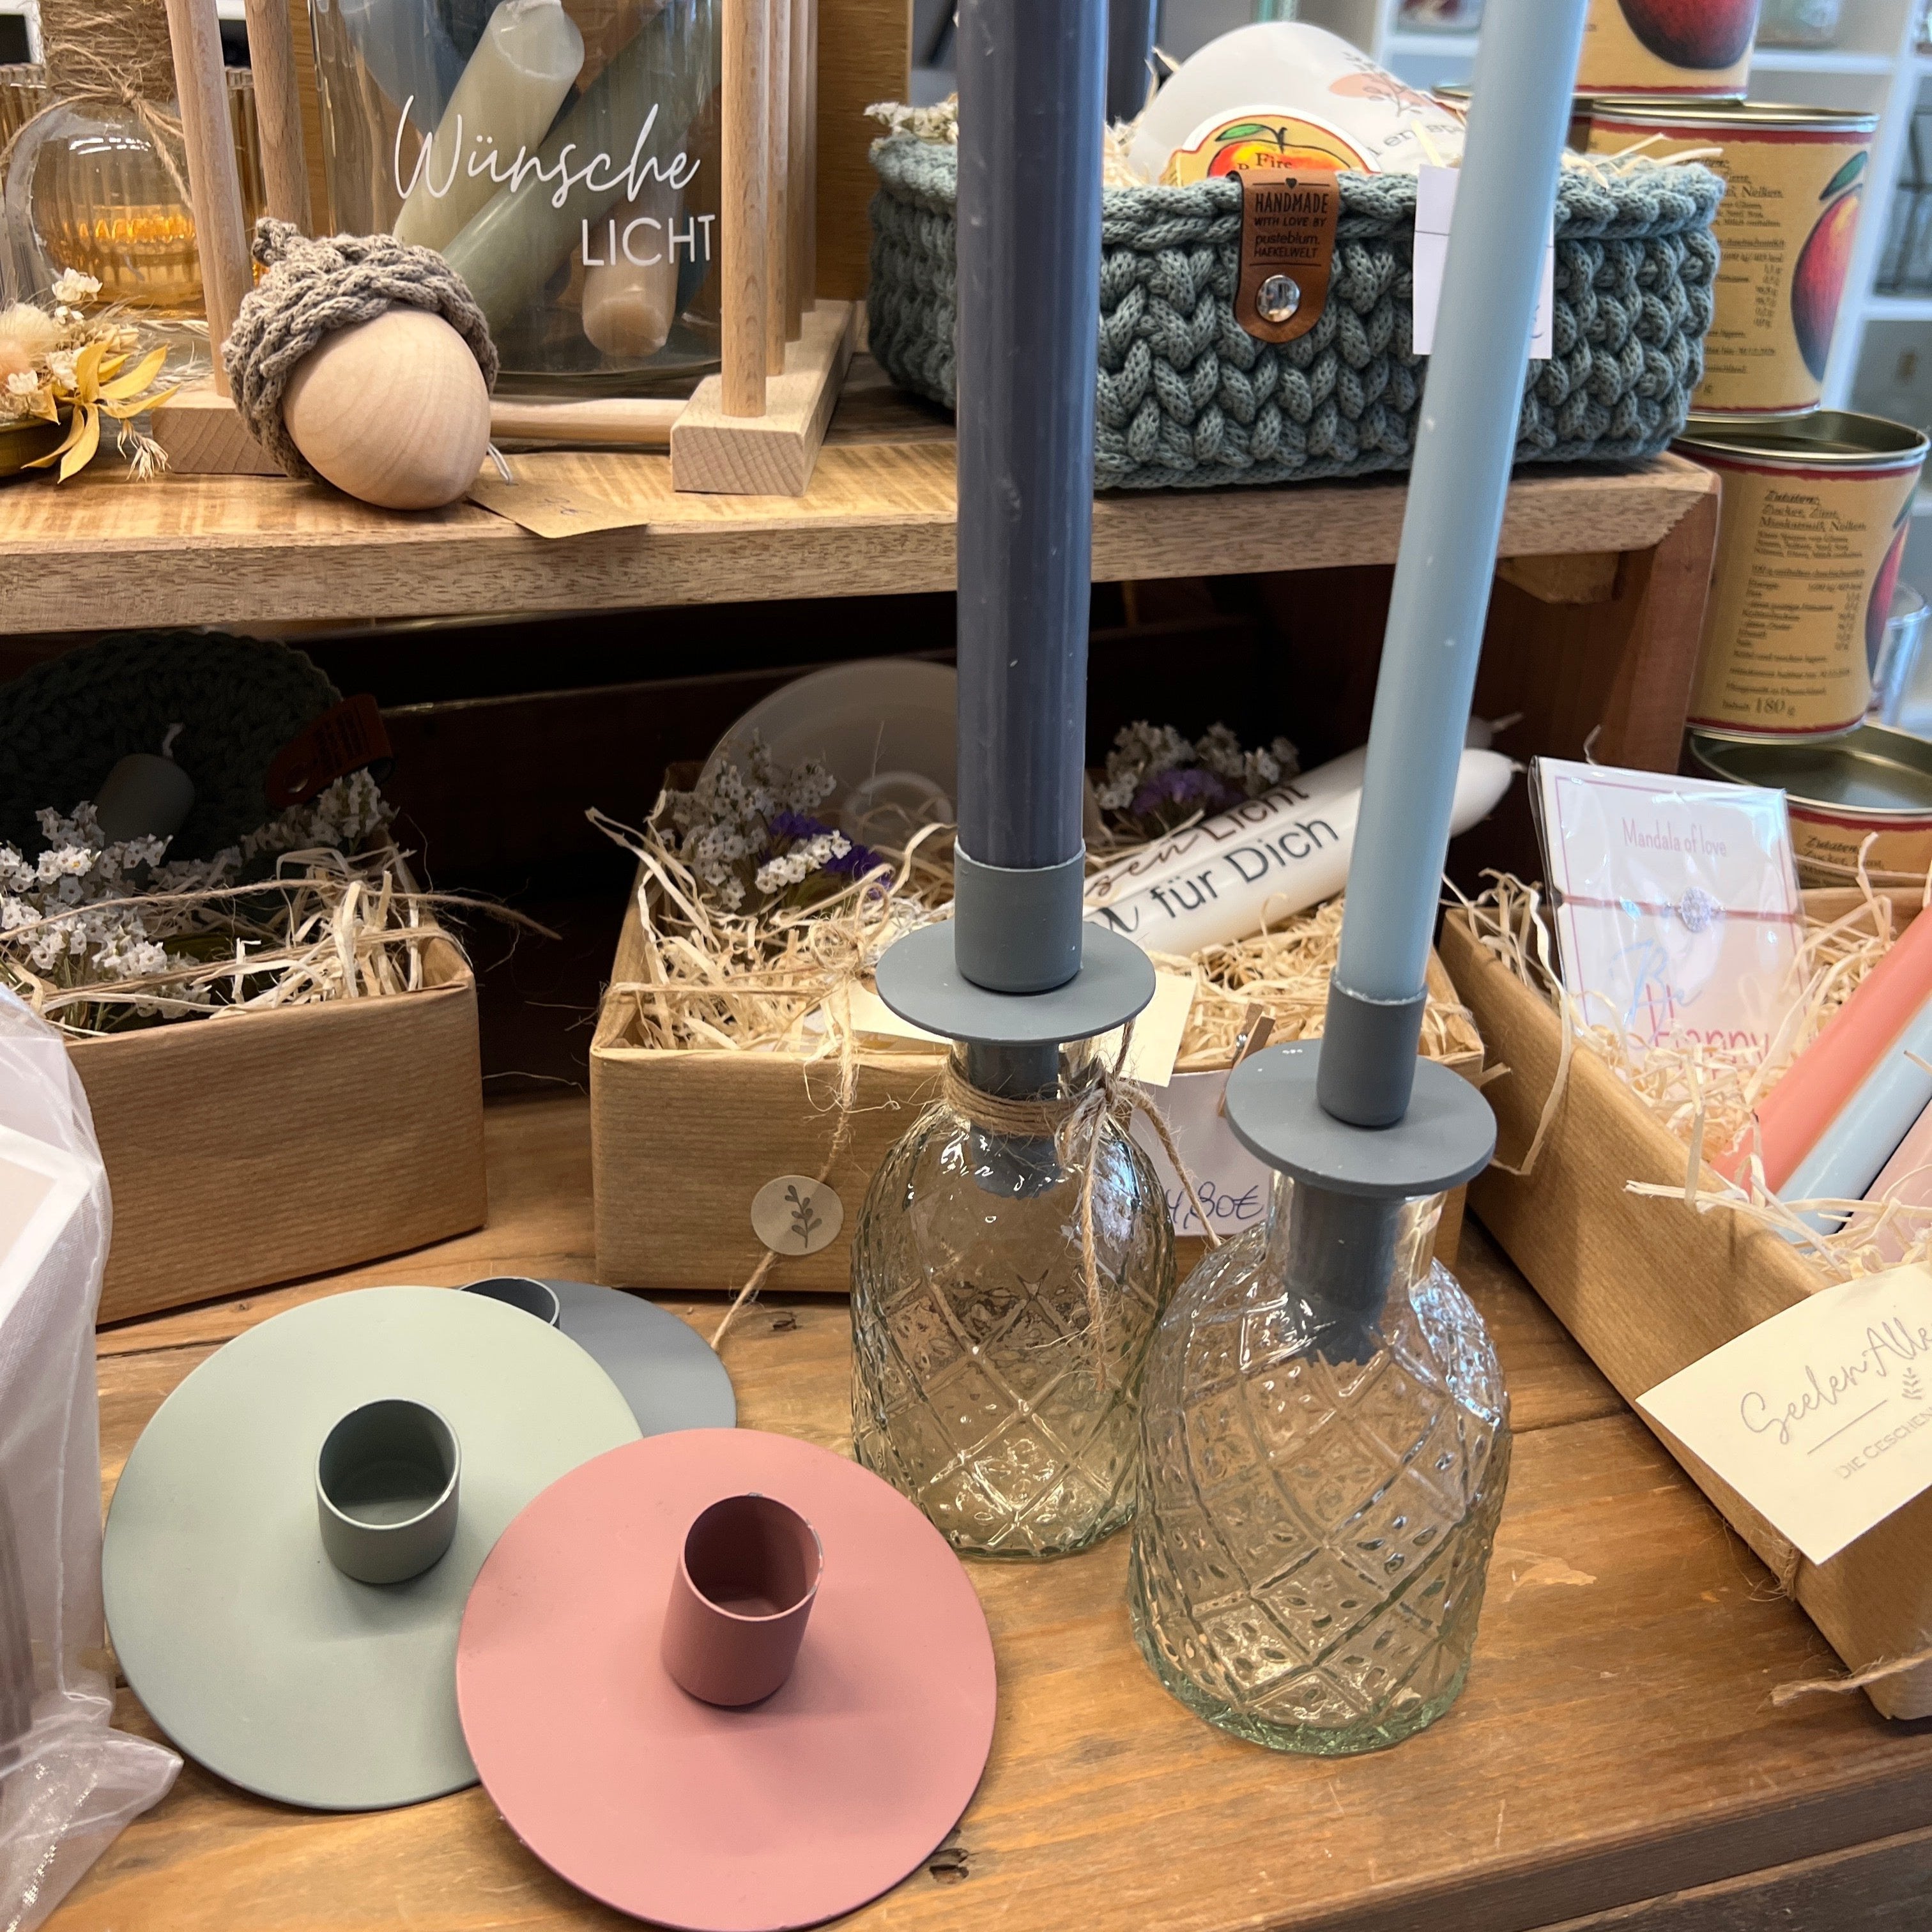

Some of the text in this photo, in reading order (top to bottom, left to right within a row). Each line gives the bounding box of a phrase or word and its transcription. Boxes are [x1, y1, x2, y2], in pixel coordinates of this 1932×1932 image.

[394, 95, 701, 208] Wünsche
[1255, 192, 1330, 213] HANDMADE
[1254, 217, 1327, 227] WITH LOVE BY
[581, 214, 716, 266] LICHT
[1755, 697, 1786, 714] 180
[1621, 816, 1728, 857] Mandala of love
[1149, 870, 1218, 919] für
[1223, 818, 1340, 884] Dich
[1835, 1455, 1866, 1479] DIE
